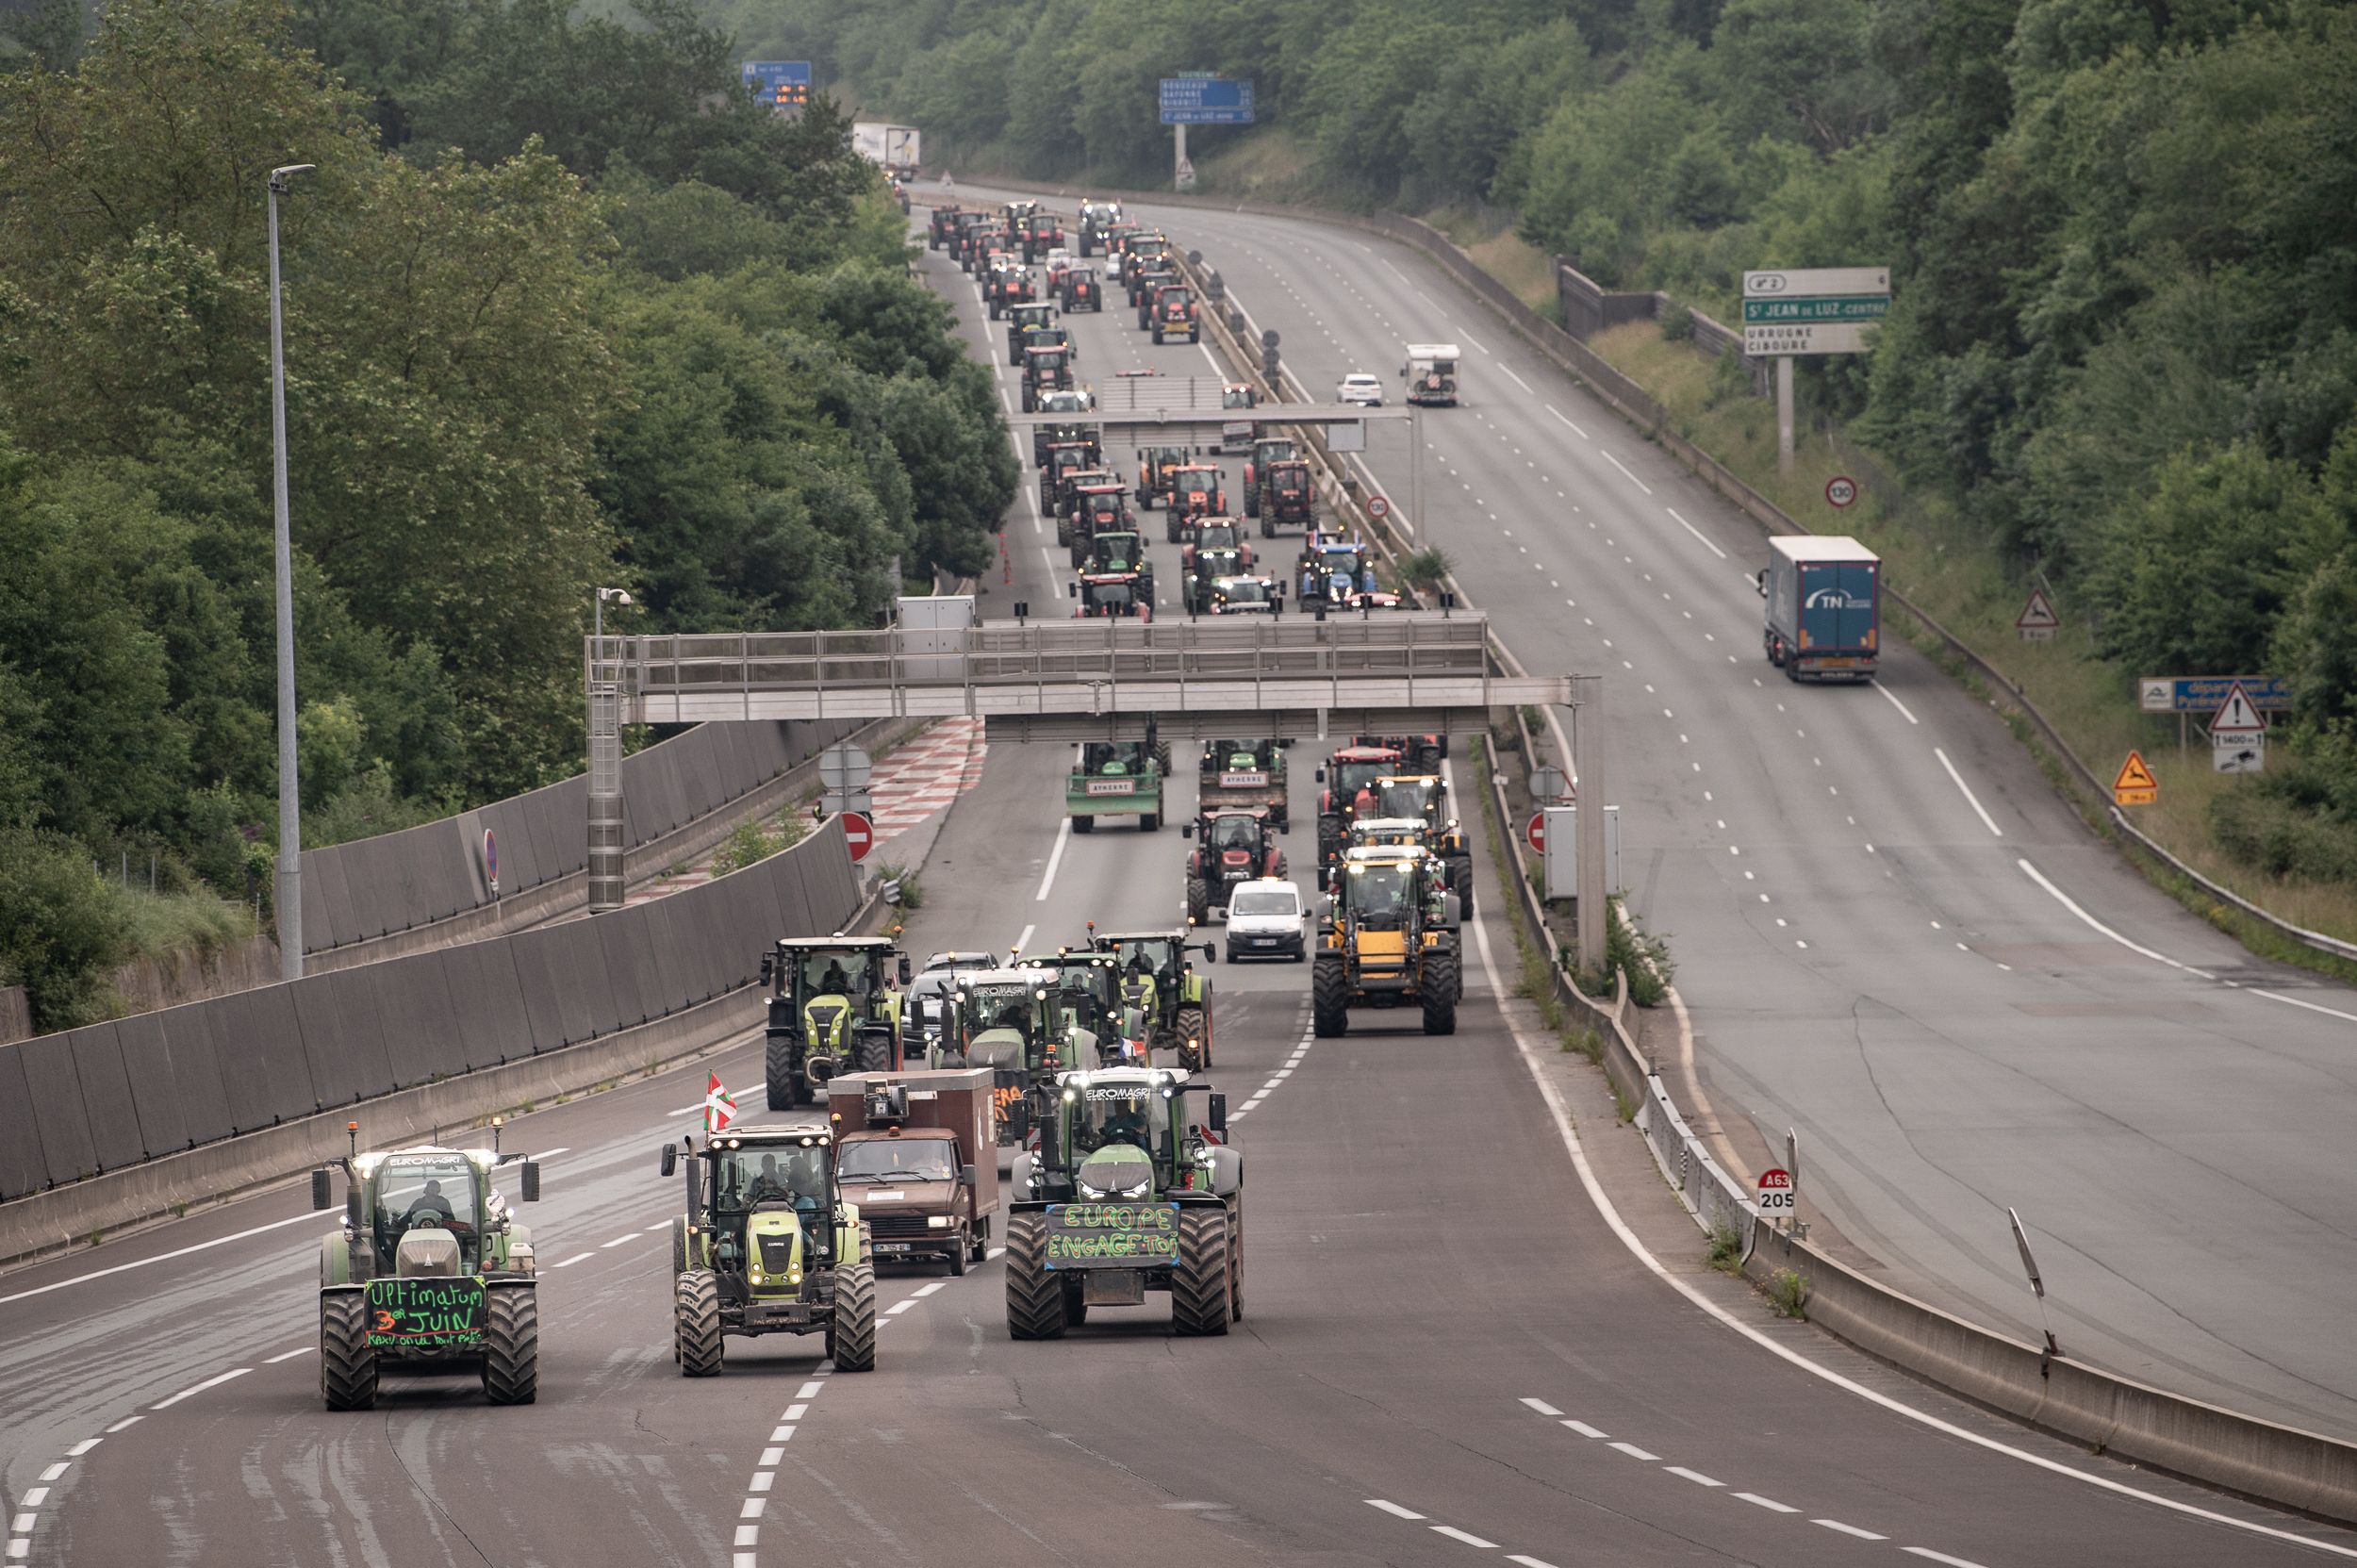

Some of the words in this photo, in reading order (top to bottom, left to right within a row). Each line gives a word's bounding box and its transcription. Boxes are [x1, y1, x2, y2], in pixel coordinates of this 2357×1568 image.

[1765, 303, 1798, 318] JEAN
[1816, 302, 1839, 316] LUZ
[1748, 340, 1807, 352] CIBOURE
[1821, 596, 1842, 608] TN
[1086, 1087, 1151, 1098] EUROMAGRI
[389, 1156, 460, 1165] EUROMAGRI
[1766, 1175, 1788, 1186] A63
[1761, 1193, 1793, 1208] 205
[1064, 1205, 1175, 1231] EUROPE
